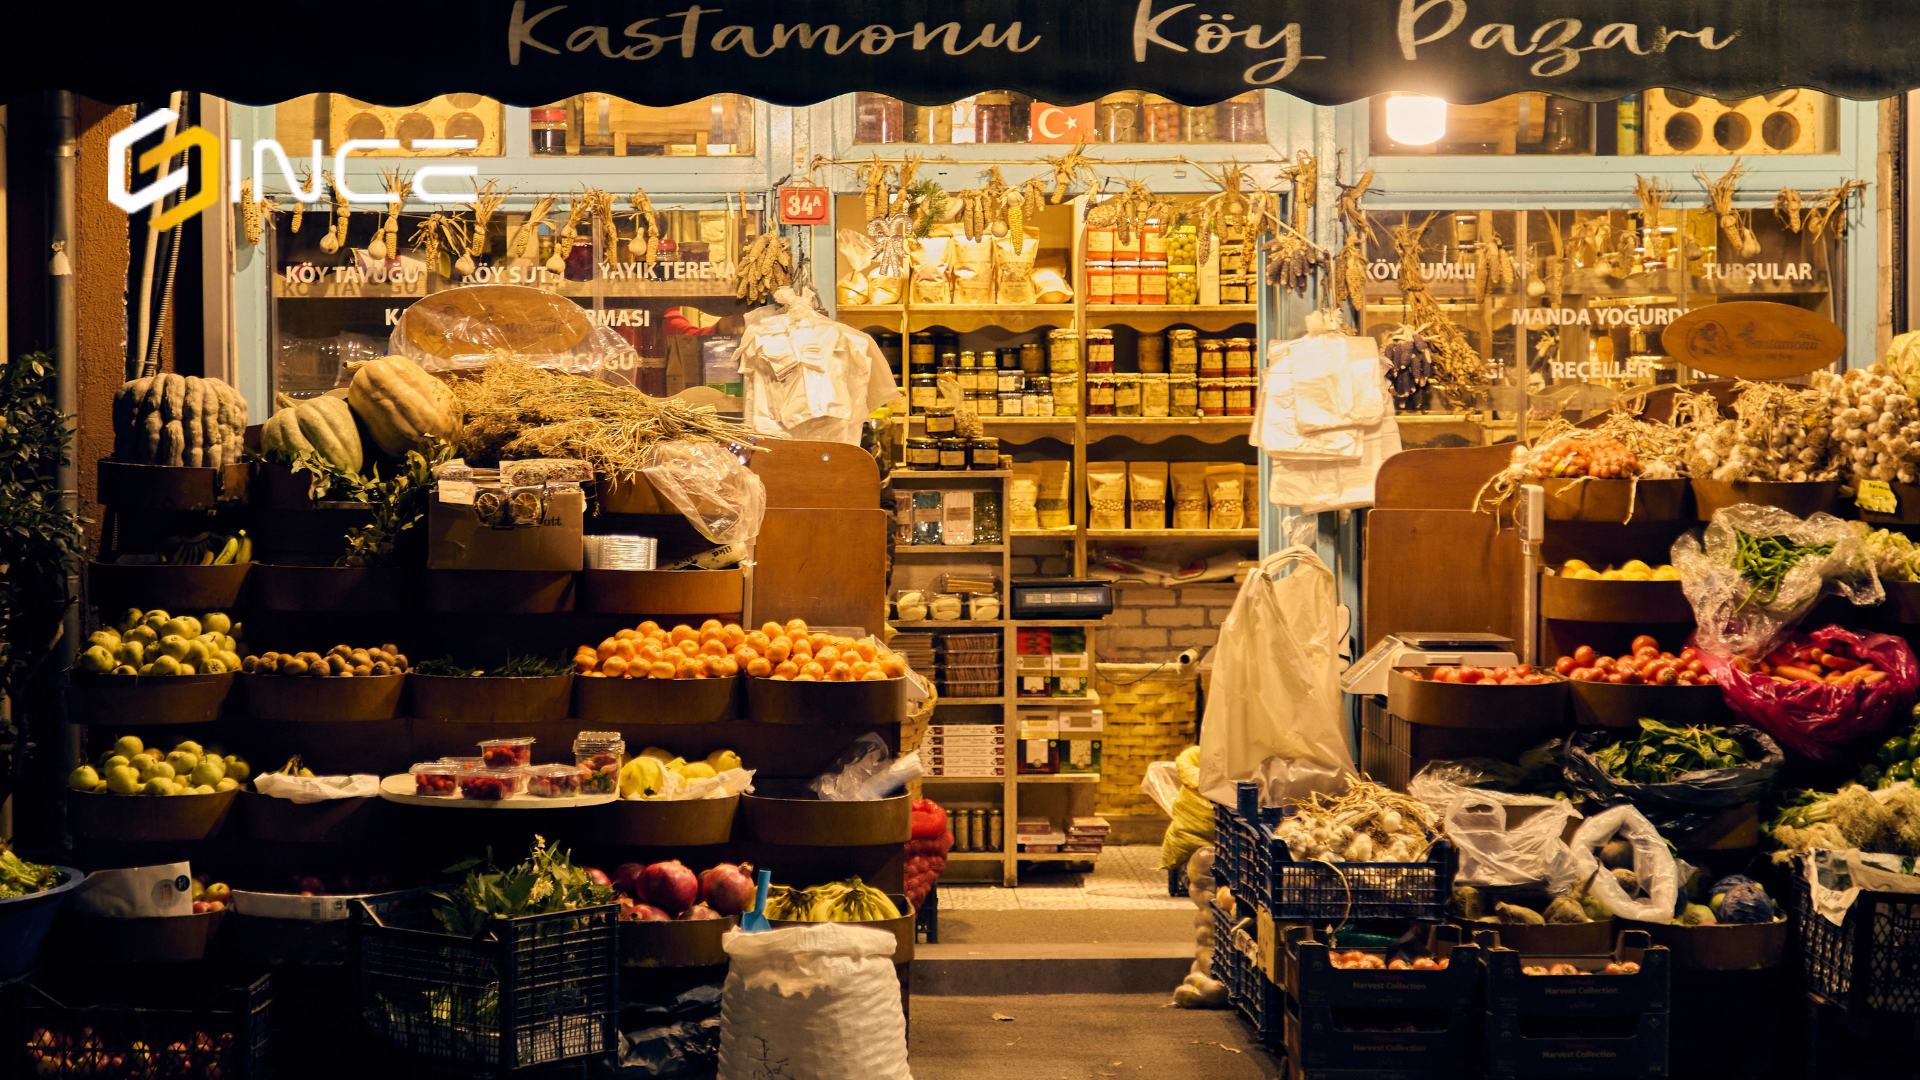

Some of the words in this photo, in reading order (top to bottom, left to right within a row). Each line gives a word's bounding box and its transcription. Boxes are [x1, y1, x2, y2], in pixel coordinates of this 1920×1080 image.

[507, 0, 1041, 65] Kastamonu
[1132, 0, 1327, 85] Köy
[787, 194, 823, 217] 34A
[285, 261, 329, 284] KÖY
[332, 261, 421, 284] TAVUĞU
[1703, 262, 1813, 285] TURŞULAR
[1511, 307, 1592, 327] MANDA
[1593, 304, 1691, 327] YOĞURD
[1551, 360, 1652, 383] REÇELLER
[1352, 981, 1385, 991] Harvest
[1386, 981, 1427, 991] Collection
[1544, 986, 1577, 996] Harvest
[1578, 986, 1619, 996] Collection
[1352, 1043, 1385, 1053] Harvest
[1386, 1043, 1427, 1053] Collection
[1541, 1050, 1575, 1060] Harvest
[1576, 1050, 1618, 1060] Collection
